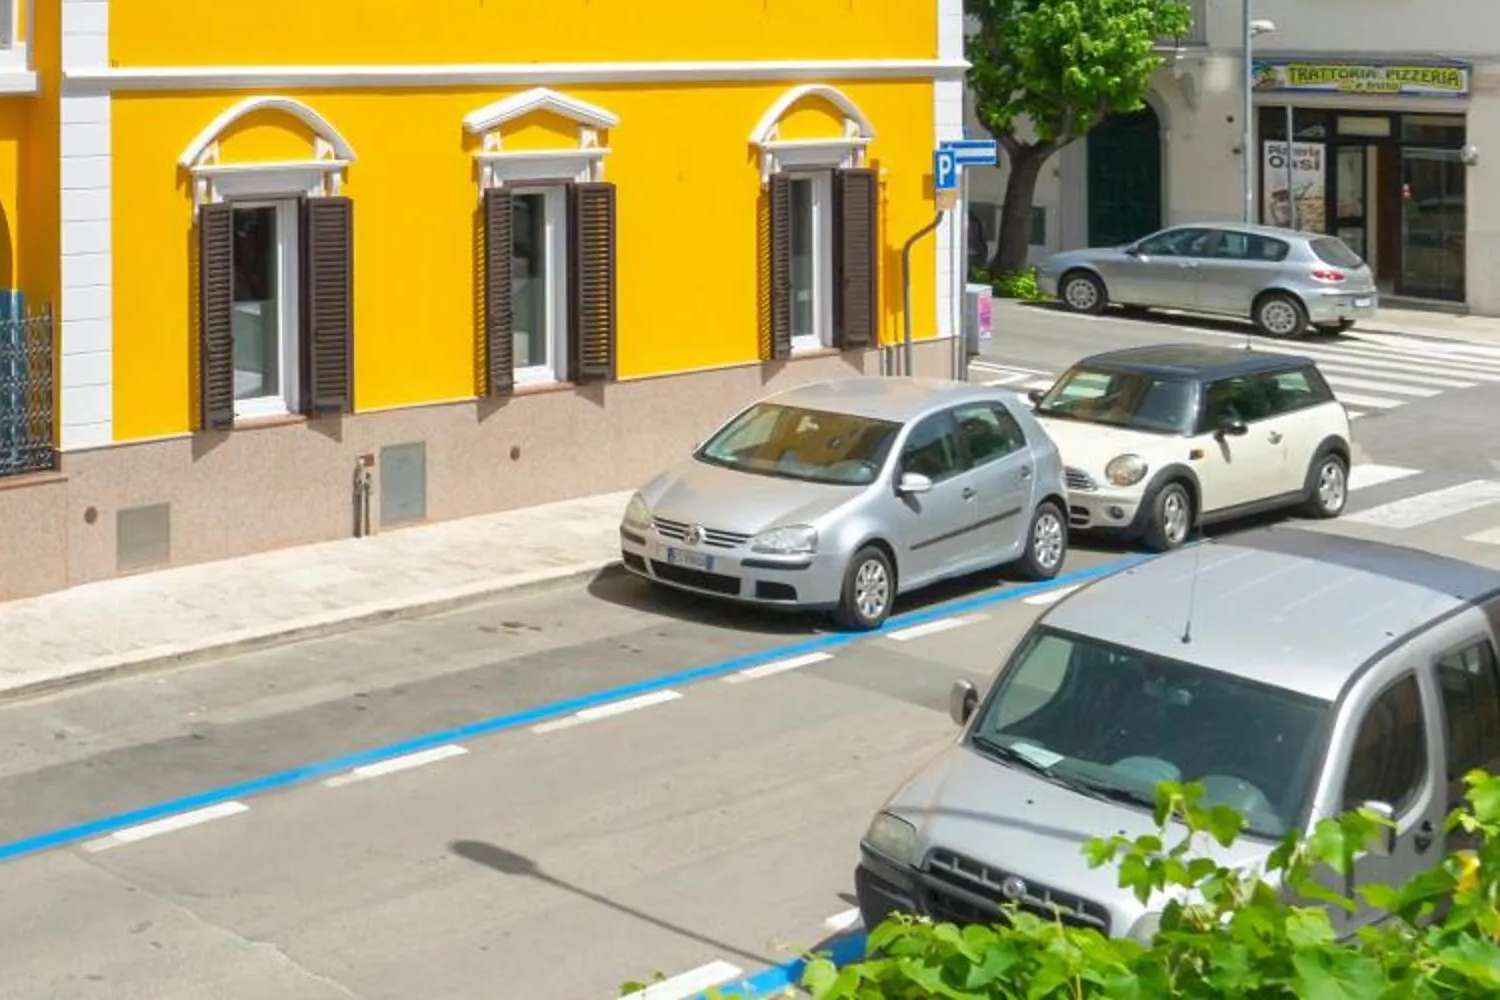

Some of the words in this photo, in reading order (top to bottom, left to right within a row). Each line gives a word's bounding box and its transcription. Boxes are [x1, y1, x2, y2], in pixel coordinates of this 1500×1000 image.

[1288, 67, 1376, 82] TRATTORIA
[1385, 68, 1459, 86] PIZZERIA
[939, 154, 952, 186] P
